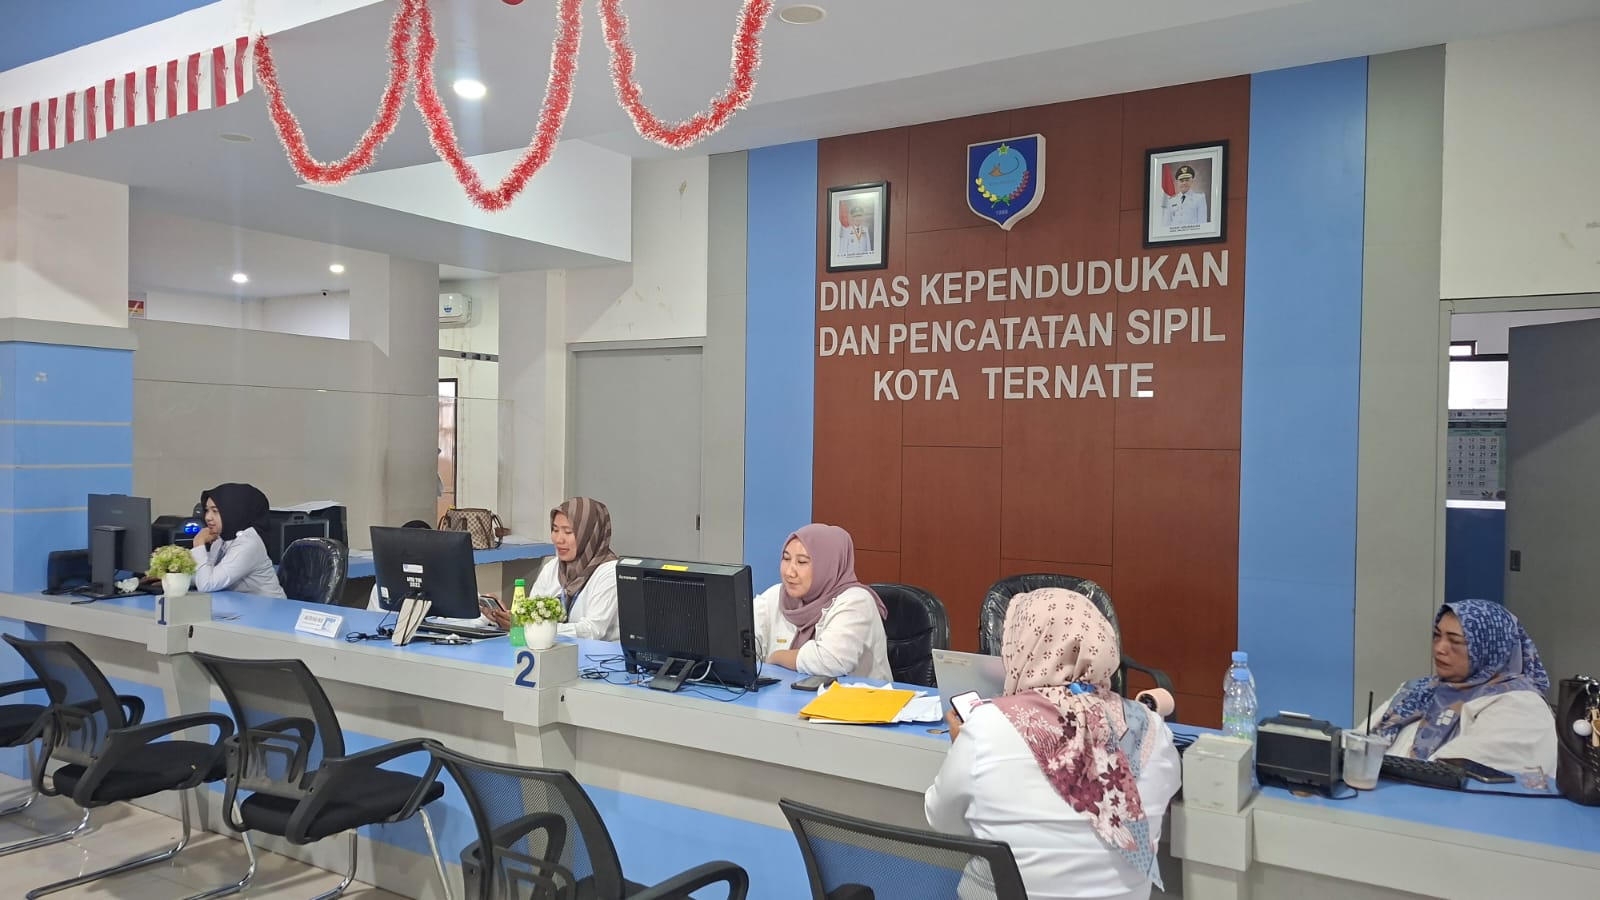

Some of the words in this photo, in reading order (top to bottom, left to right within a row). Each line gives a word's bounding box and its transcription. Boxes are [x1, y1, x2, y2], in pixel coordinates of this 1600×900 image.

[820, 275, 910, 311] DINAS
[920, 250, 1229, 306] KEPENDUDUKAN
[819, 324, 880, 357] DAN
[888, 312, 1113, 355] PENCATATAN
[1126, 306, 1226, 345] SIPIL
[873, 368, 960, 401] KOTA
[981, 363, 1154, 400] TERNATE
[157, 597, 167, 625] 1
[515, 651, 536, 688] 2
